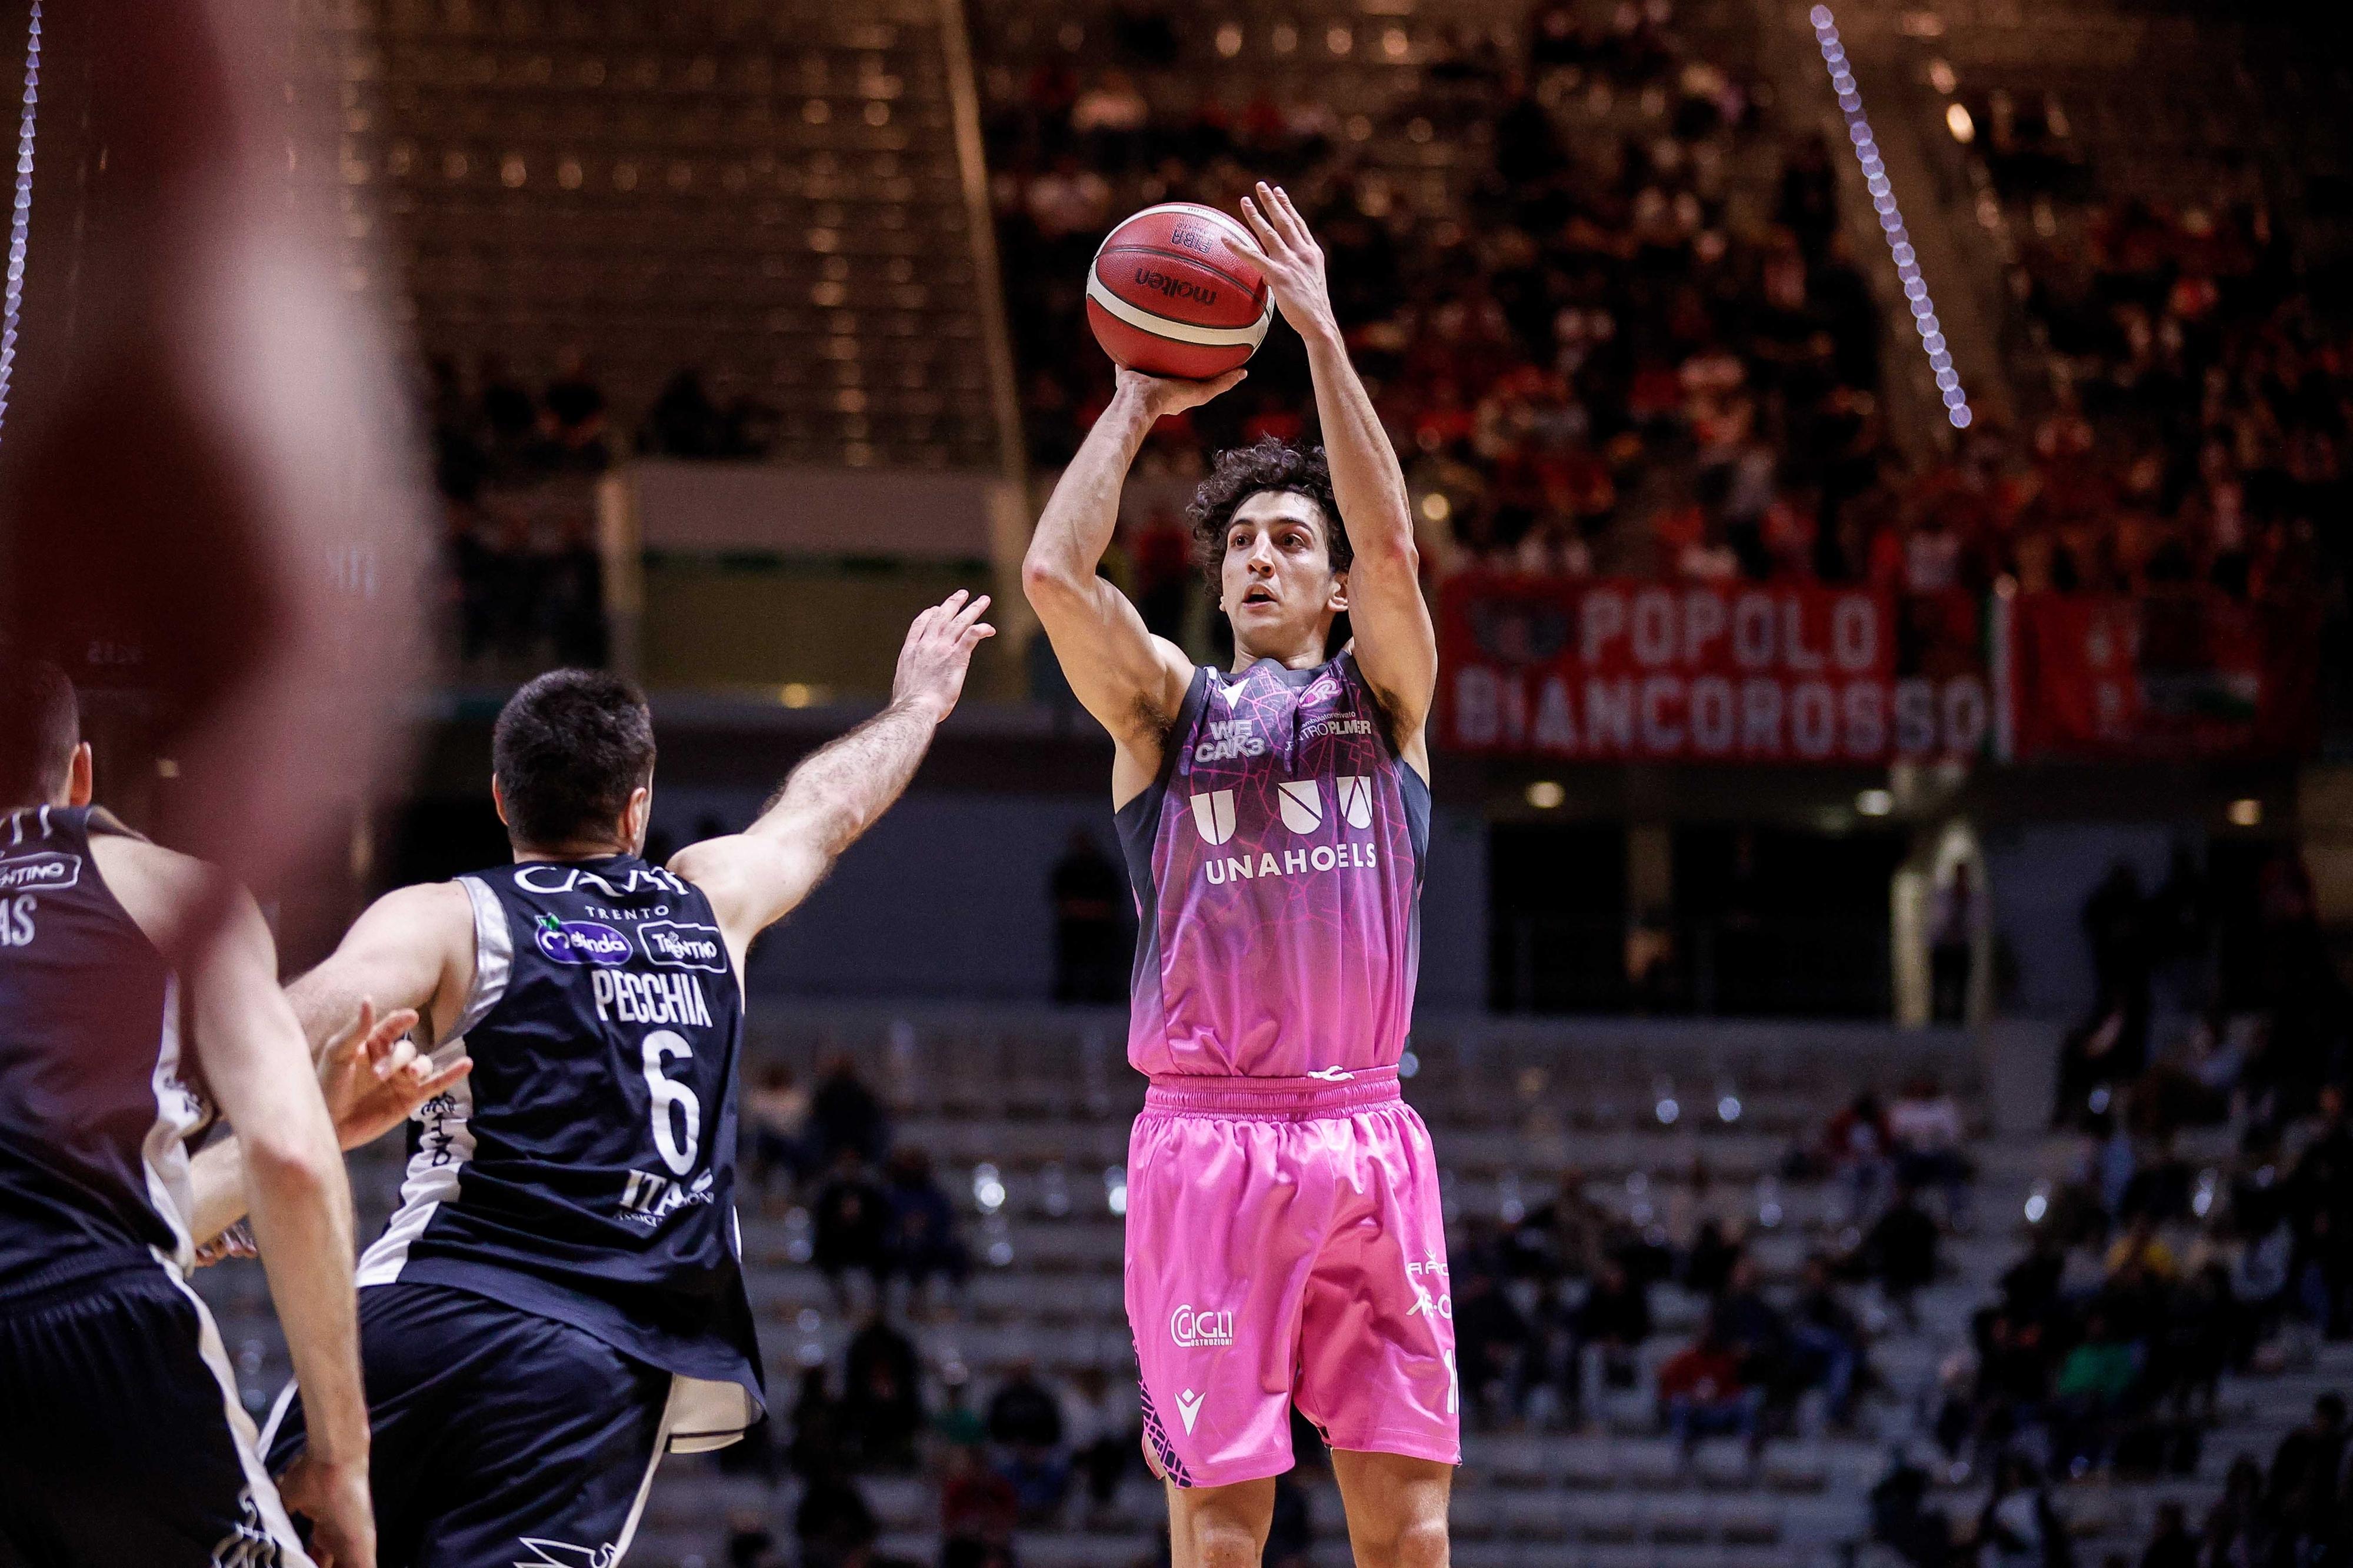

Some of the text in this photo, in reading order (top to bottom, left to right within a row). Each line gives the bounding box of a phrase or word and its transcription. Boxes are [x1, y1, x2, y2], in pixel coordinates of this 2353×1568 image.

[1171, 229, 1212, 253] FIBA
[1135, 268, 1217, 305] molten
[1579, 588, 1878, 672] POPOLO
[1209, 719, 1253, 740] WE
[585, 905, 670, 921] TRENTO
[592, 969, 713, 1028] PECCHIA
[641, 1029, 701, 1176] 6
